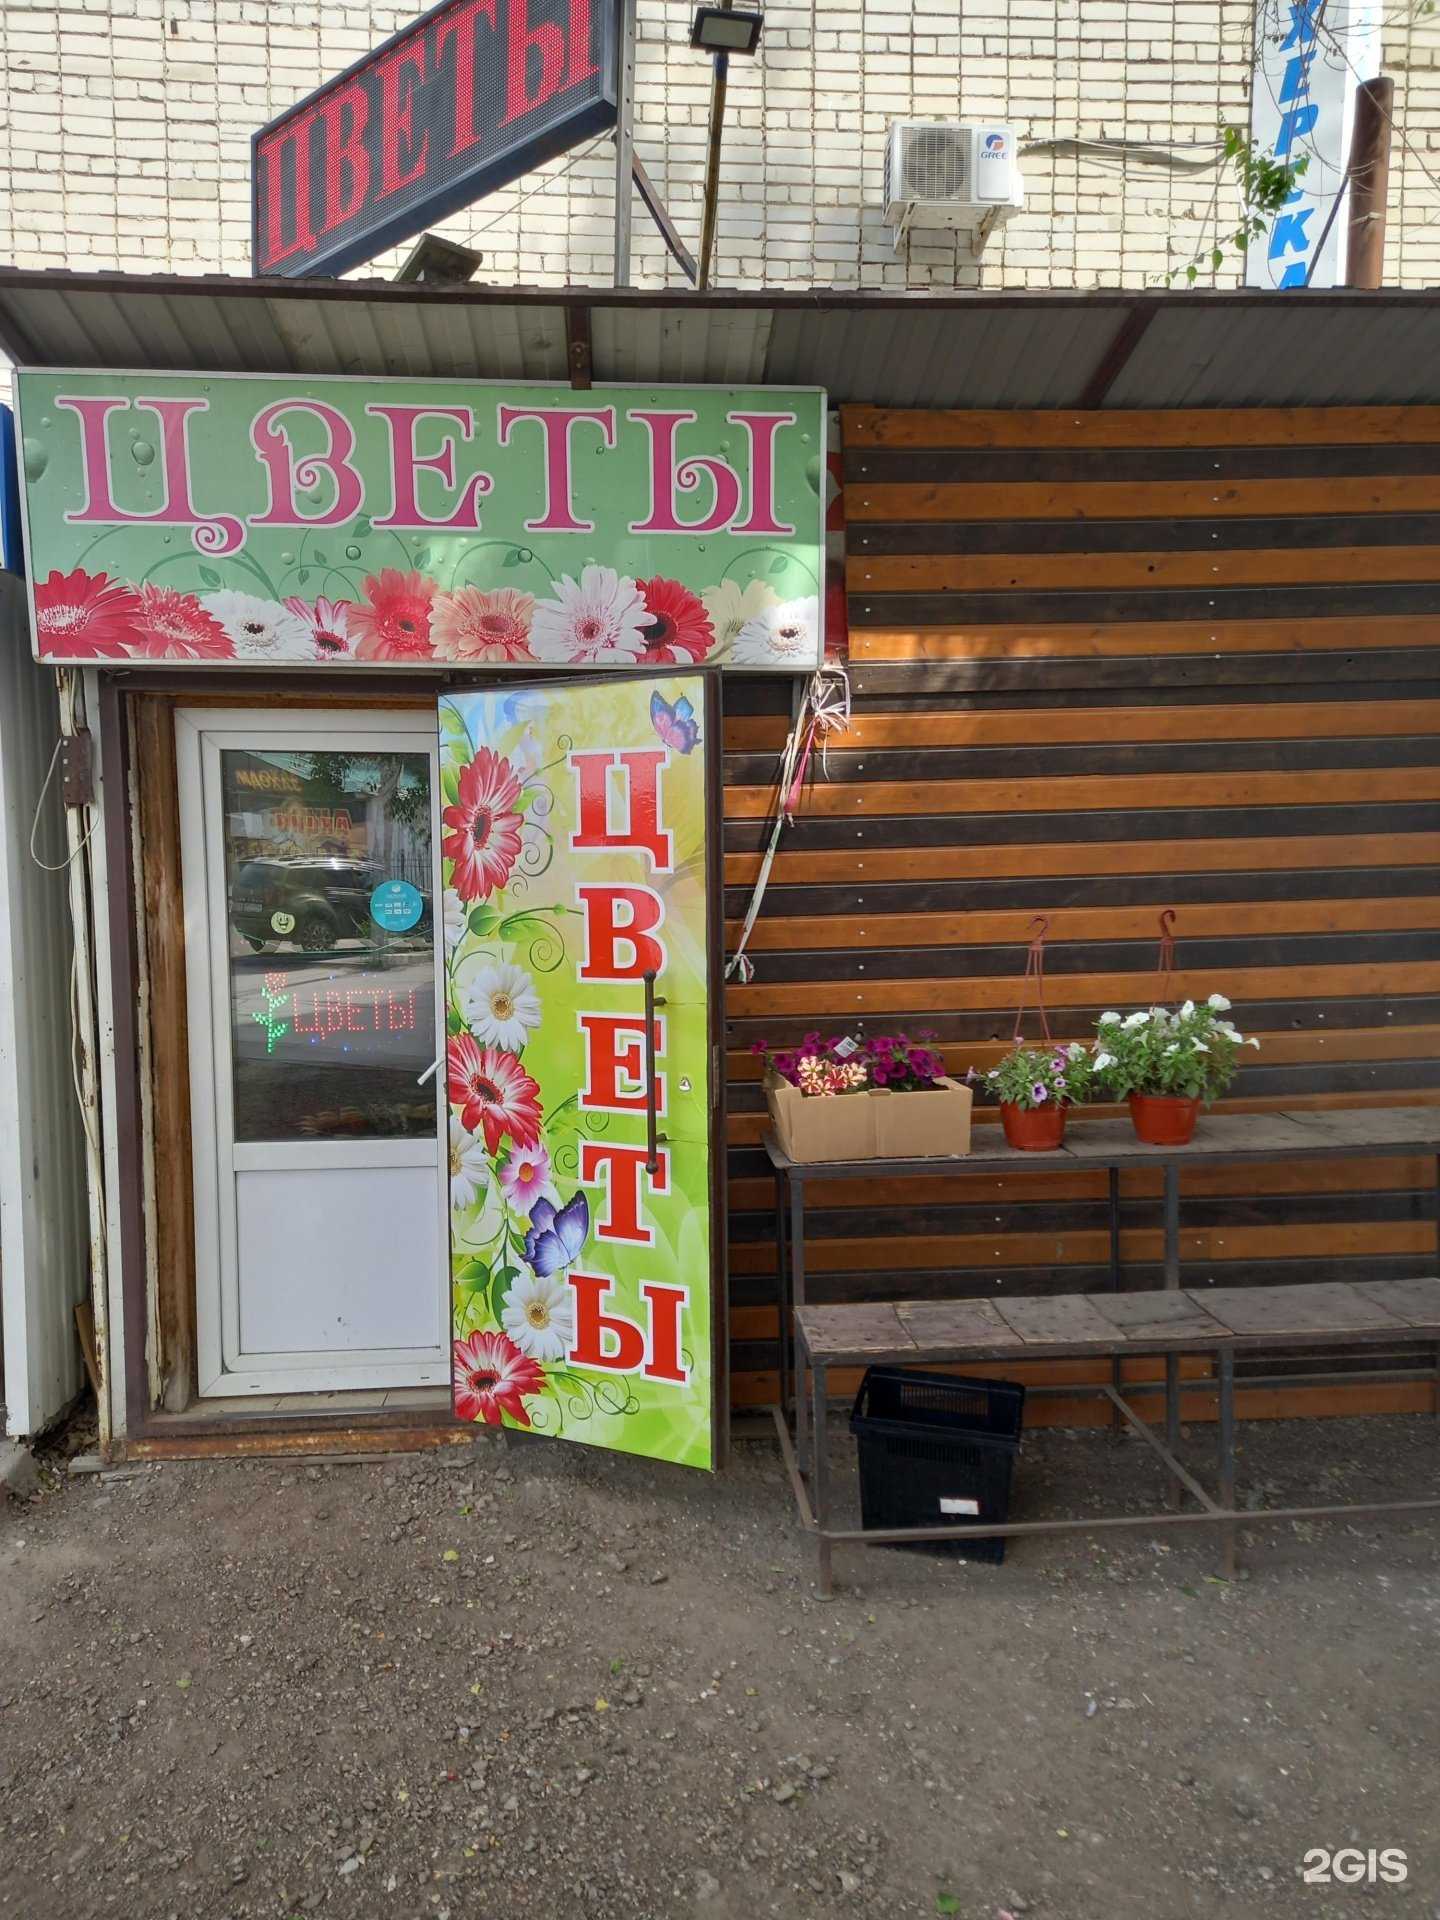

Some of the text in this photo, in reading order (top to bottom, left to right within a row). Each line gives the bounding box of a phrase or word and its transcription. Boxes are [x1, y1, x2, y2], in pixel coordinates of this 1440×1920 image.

[259, 0, 601, 269] ЦВЕТЫ
[980, 151, 1008, 160] GREE
[55, 395, 798, 557] ЦВЕТЫ
[292, 988, 417, 1040] ЦВЕТЫ
[567, 746, 691, 1384] ЦВЕТЫ
